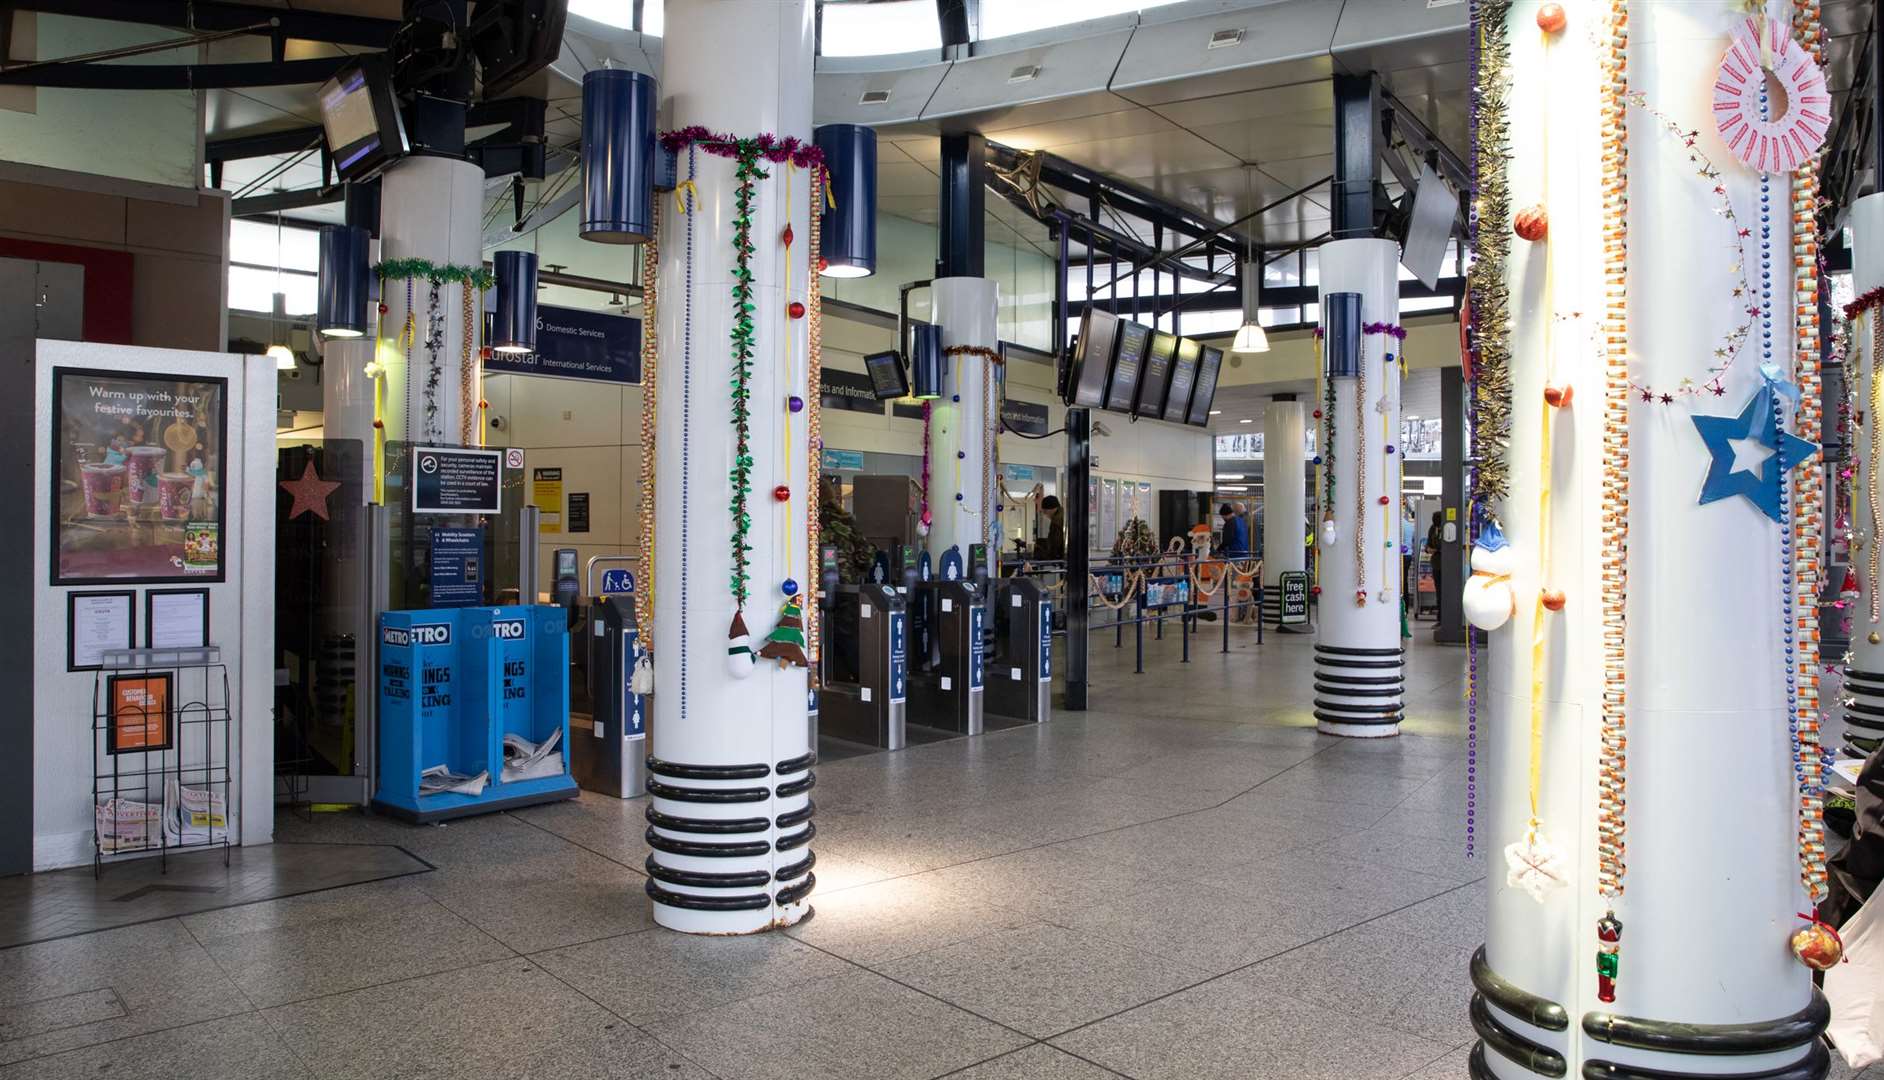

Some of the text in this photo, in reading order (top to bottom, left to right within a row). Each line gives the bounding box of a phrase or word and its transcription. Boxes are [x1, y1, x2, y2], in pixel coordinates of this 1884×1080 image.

[546, 324, 578, 335] Domestic
[579, 327, 605, 338] Services
[543, 358, 585, 370] International
[586, 363, 612, 373] Services
[89, 386, 200, 406] Warm up with your
[831, 385, 845, 396] and
[94, 402, 194, 418] festive favourites.
[1286, 580, 1304, 591] free
[1285, 591, 1305, 602] cash
[1285, 602, 1304, 613] here
[384, 629, 408, 645] METRO
[410, 626, 448, 642] ETRO
[492, 622, 523, 638] TRO
[504, 661, 525, 677] NGS
